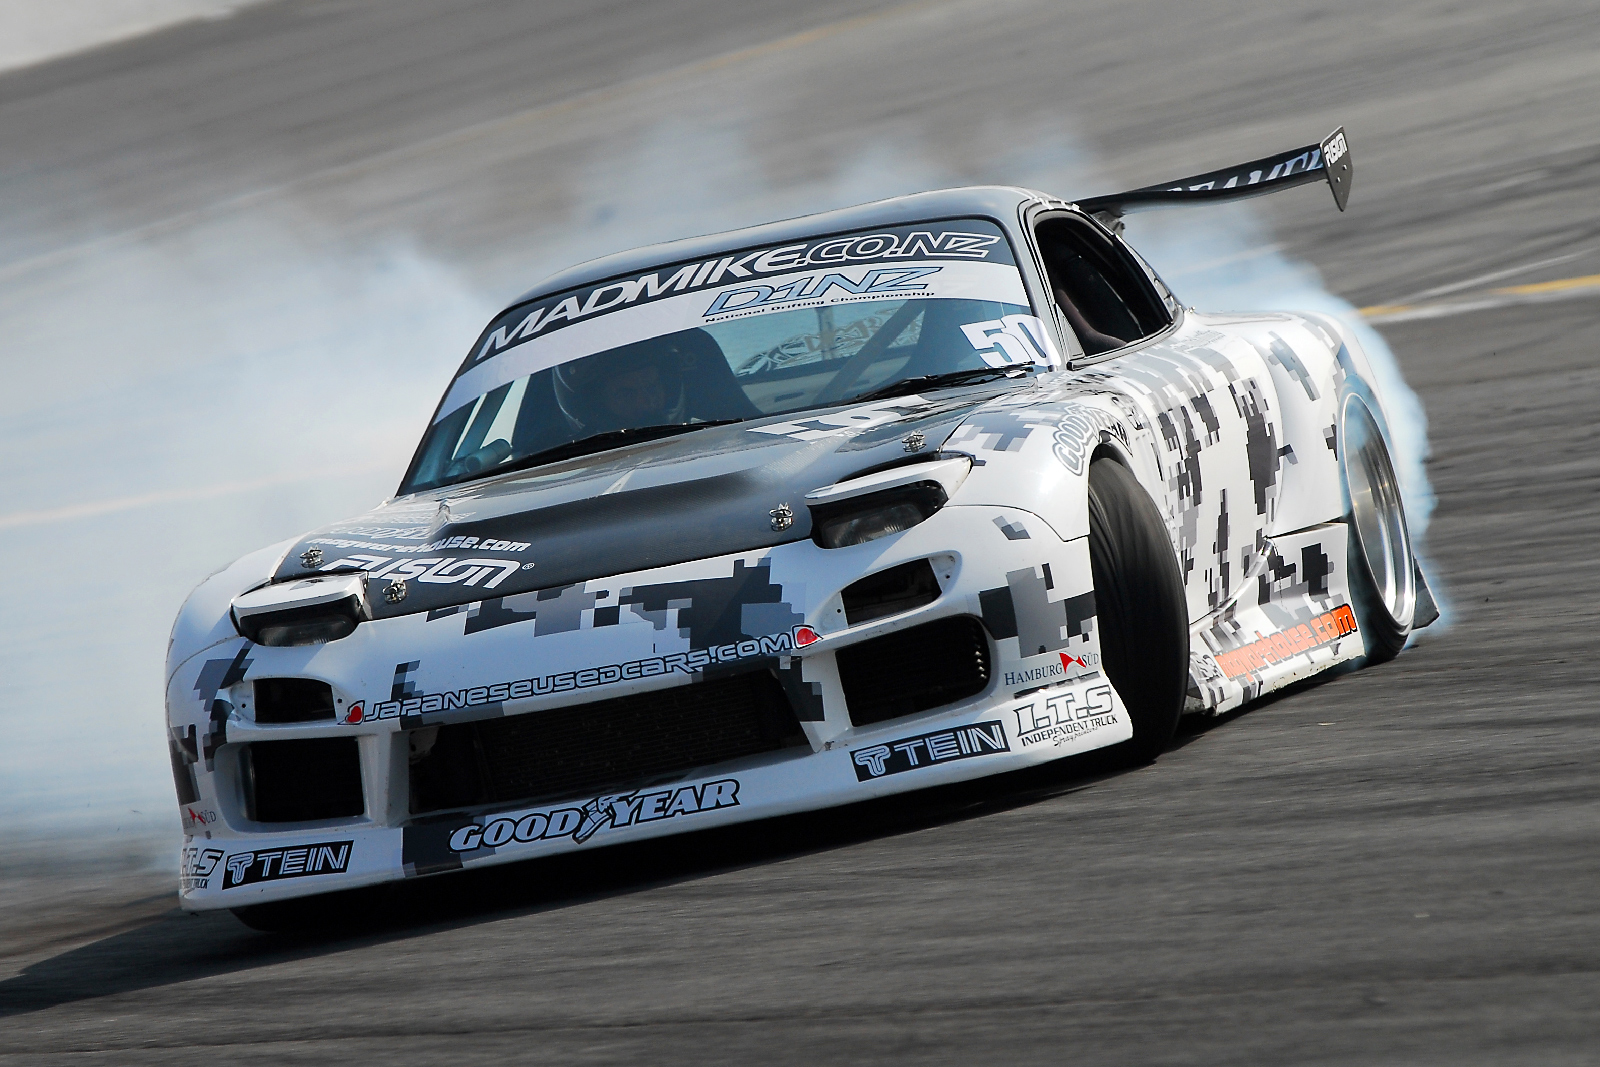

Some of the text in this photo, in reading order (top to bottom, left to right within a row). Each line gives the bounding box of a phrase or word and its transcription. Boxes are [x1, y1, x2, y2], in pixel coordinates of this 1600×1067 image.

[475, 231, 1001, 361] MADMIKE.CO.NZ
[702, 266, 944, 318] D1NZ
[705, 291, 935, 323] National Drifting Championship
[959, 314, 1061, 367] 50
[1004, 663, 1063, 686] HAMBURG
[893, 724, 1006, 766] TEIN
[1021, 714, 1119, 747] INDEPENDENT TRUCK
[257, 844, 349, 877] TEIN
